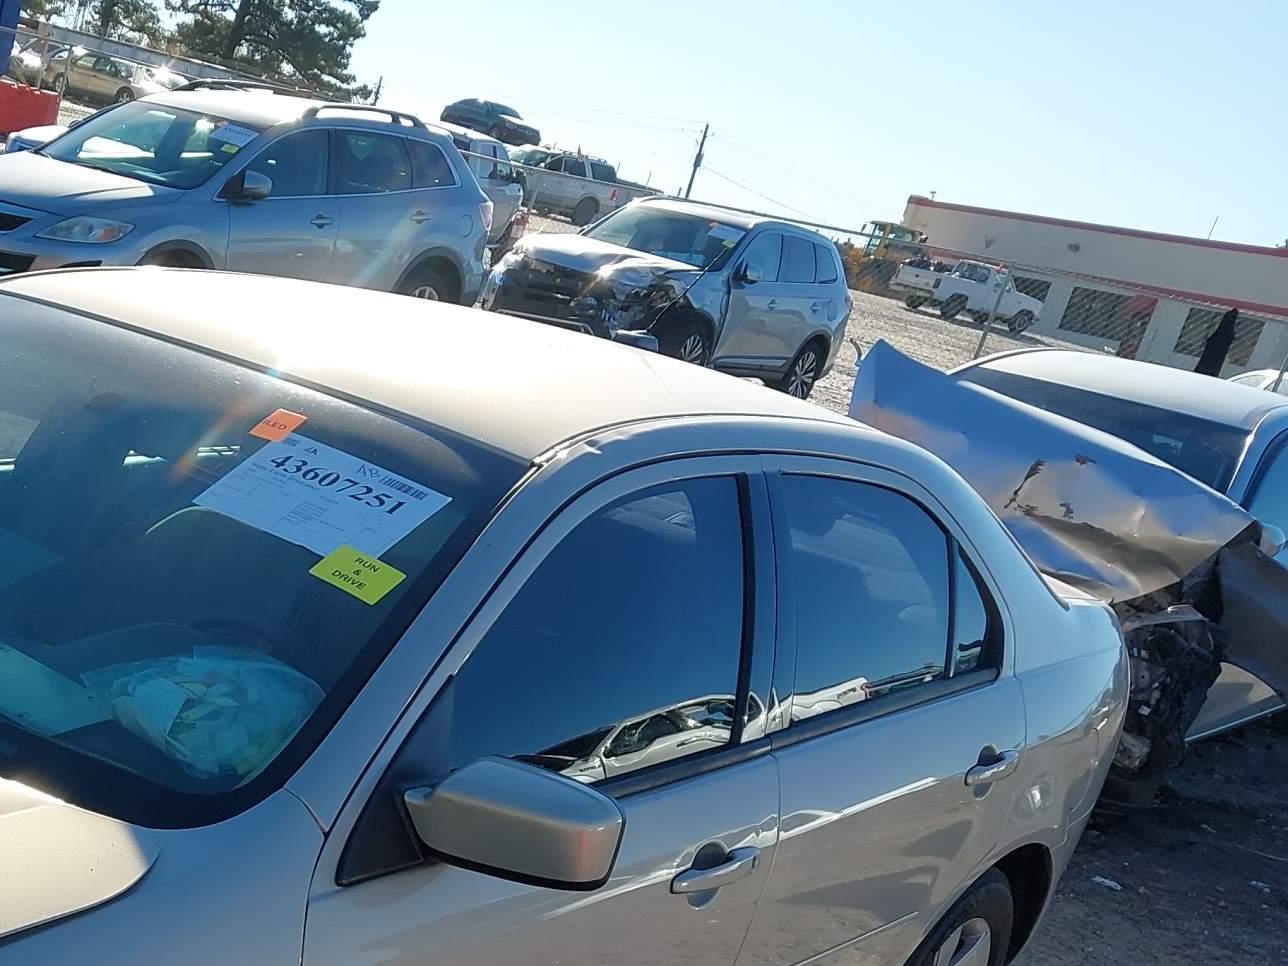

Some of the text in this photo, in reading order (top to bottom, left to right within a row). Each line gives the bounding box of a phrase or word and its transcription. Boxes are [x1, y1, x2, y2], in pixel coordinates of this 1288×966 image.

[269, 454, 409, 516] 43607251
[352, 568, 362, 577] &
[353, 556, 381, 573] RUN
[331, 569, 368, 590] DRIVE
